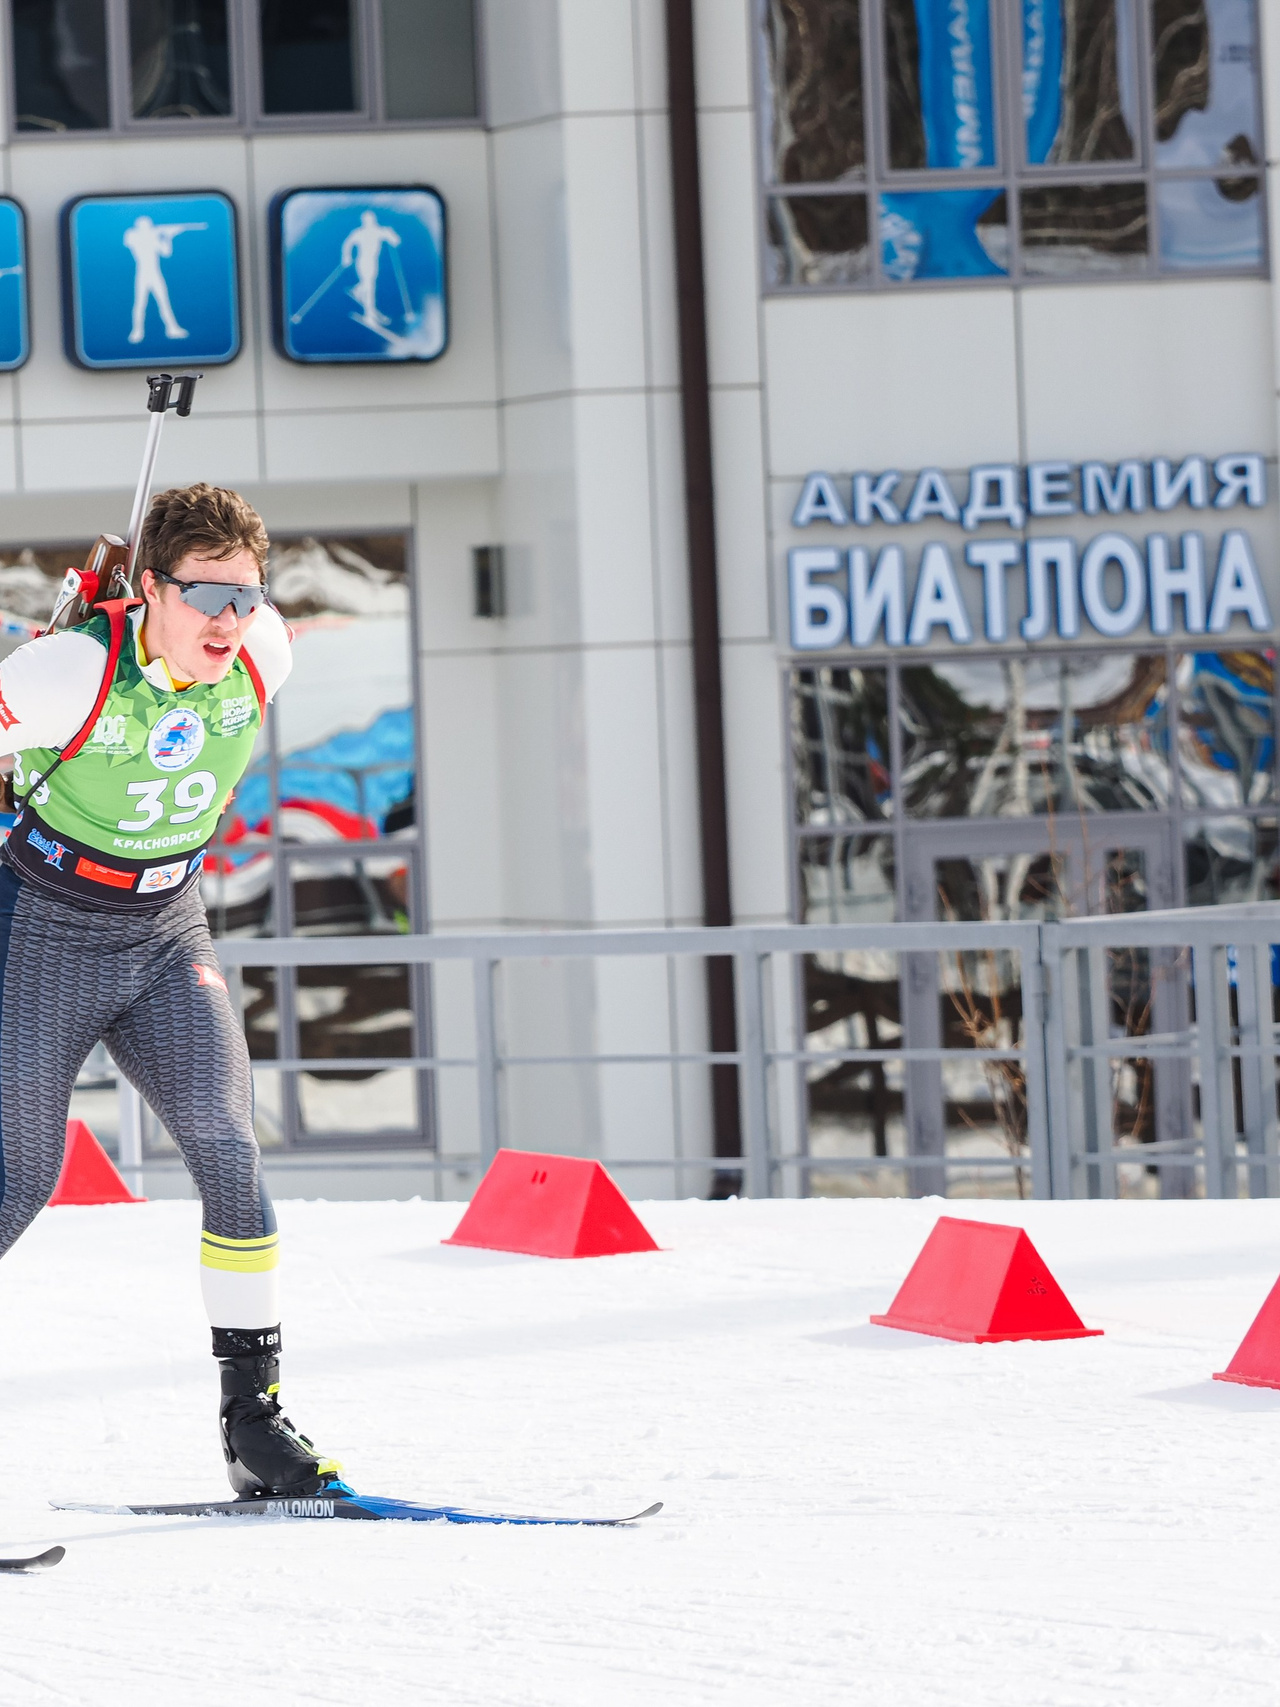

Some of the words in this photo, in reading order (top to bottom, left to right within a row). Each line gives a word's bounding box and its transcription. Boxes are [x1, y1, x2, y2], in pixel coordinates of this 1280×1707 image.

[792, 452, 1267, 531] АКАДЕМИЯ
[789, 529, 1275, 651] БИАТЛОНА
[117, 771, 217, 832] 39
[113, 829, 202, 850] КРАСНОЯРСК
[257, 1332, 279, 1346] 189
[267, 1500, 335, 1518] SALOMON
